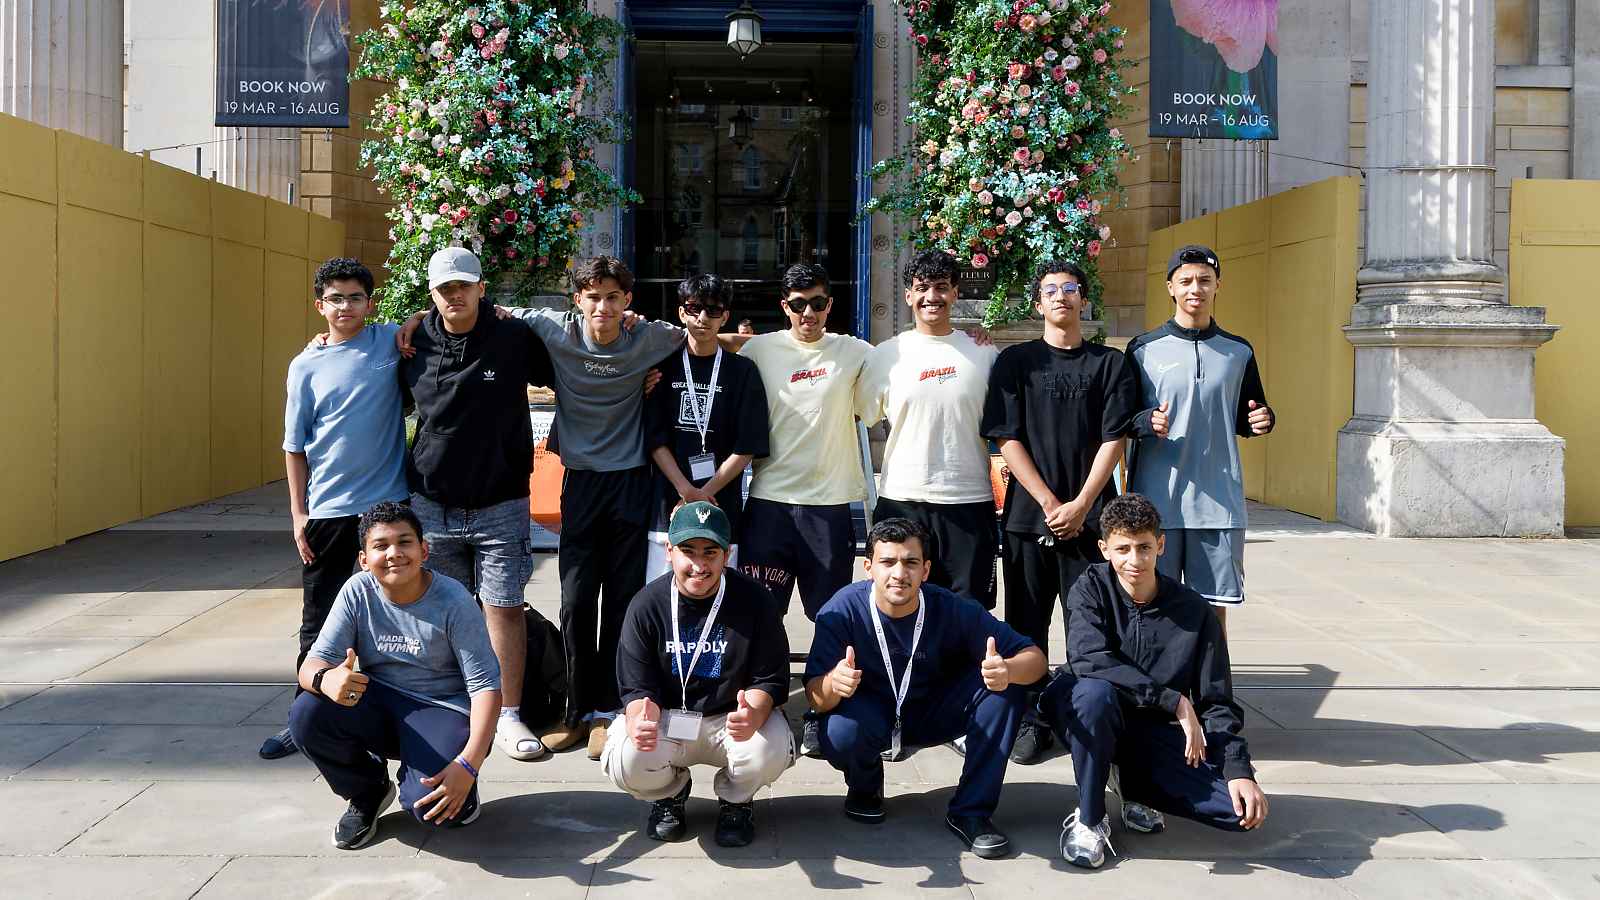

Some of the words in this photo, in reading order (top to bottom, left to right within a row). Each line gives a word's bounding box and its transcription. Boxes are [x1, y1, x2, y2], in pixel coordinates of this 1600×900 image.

[240, 81, 284, 92] BOOK
[288, 82, 325, 93] NOW
[1173, 93, 1216, 105] BOOK
[1220, 94, 1256, 106] NOW
[224, 101, 238, 113] 19
[242, 102, 276, 114] MAR
[291, 102, 304, 114] 16
[308, 103, 340, 115] AUG
[1159, 112, 1172, 125] 19
[1176, 113, 1208, 126] MAR
[1222, 114, 1236, 126] 16
[1239, 115, 1269, 127] AUG
[790, 367, 828, 383] BRAZIL
[919, 366, 957, 381] BRAZIL
[765, 567, 791, 586] YORK
[378, 635, 404, 643] MADE
[377, 643, 421, 655] MVMNT
[665, 641, 728, 654] RAPDLY
